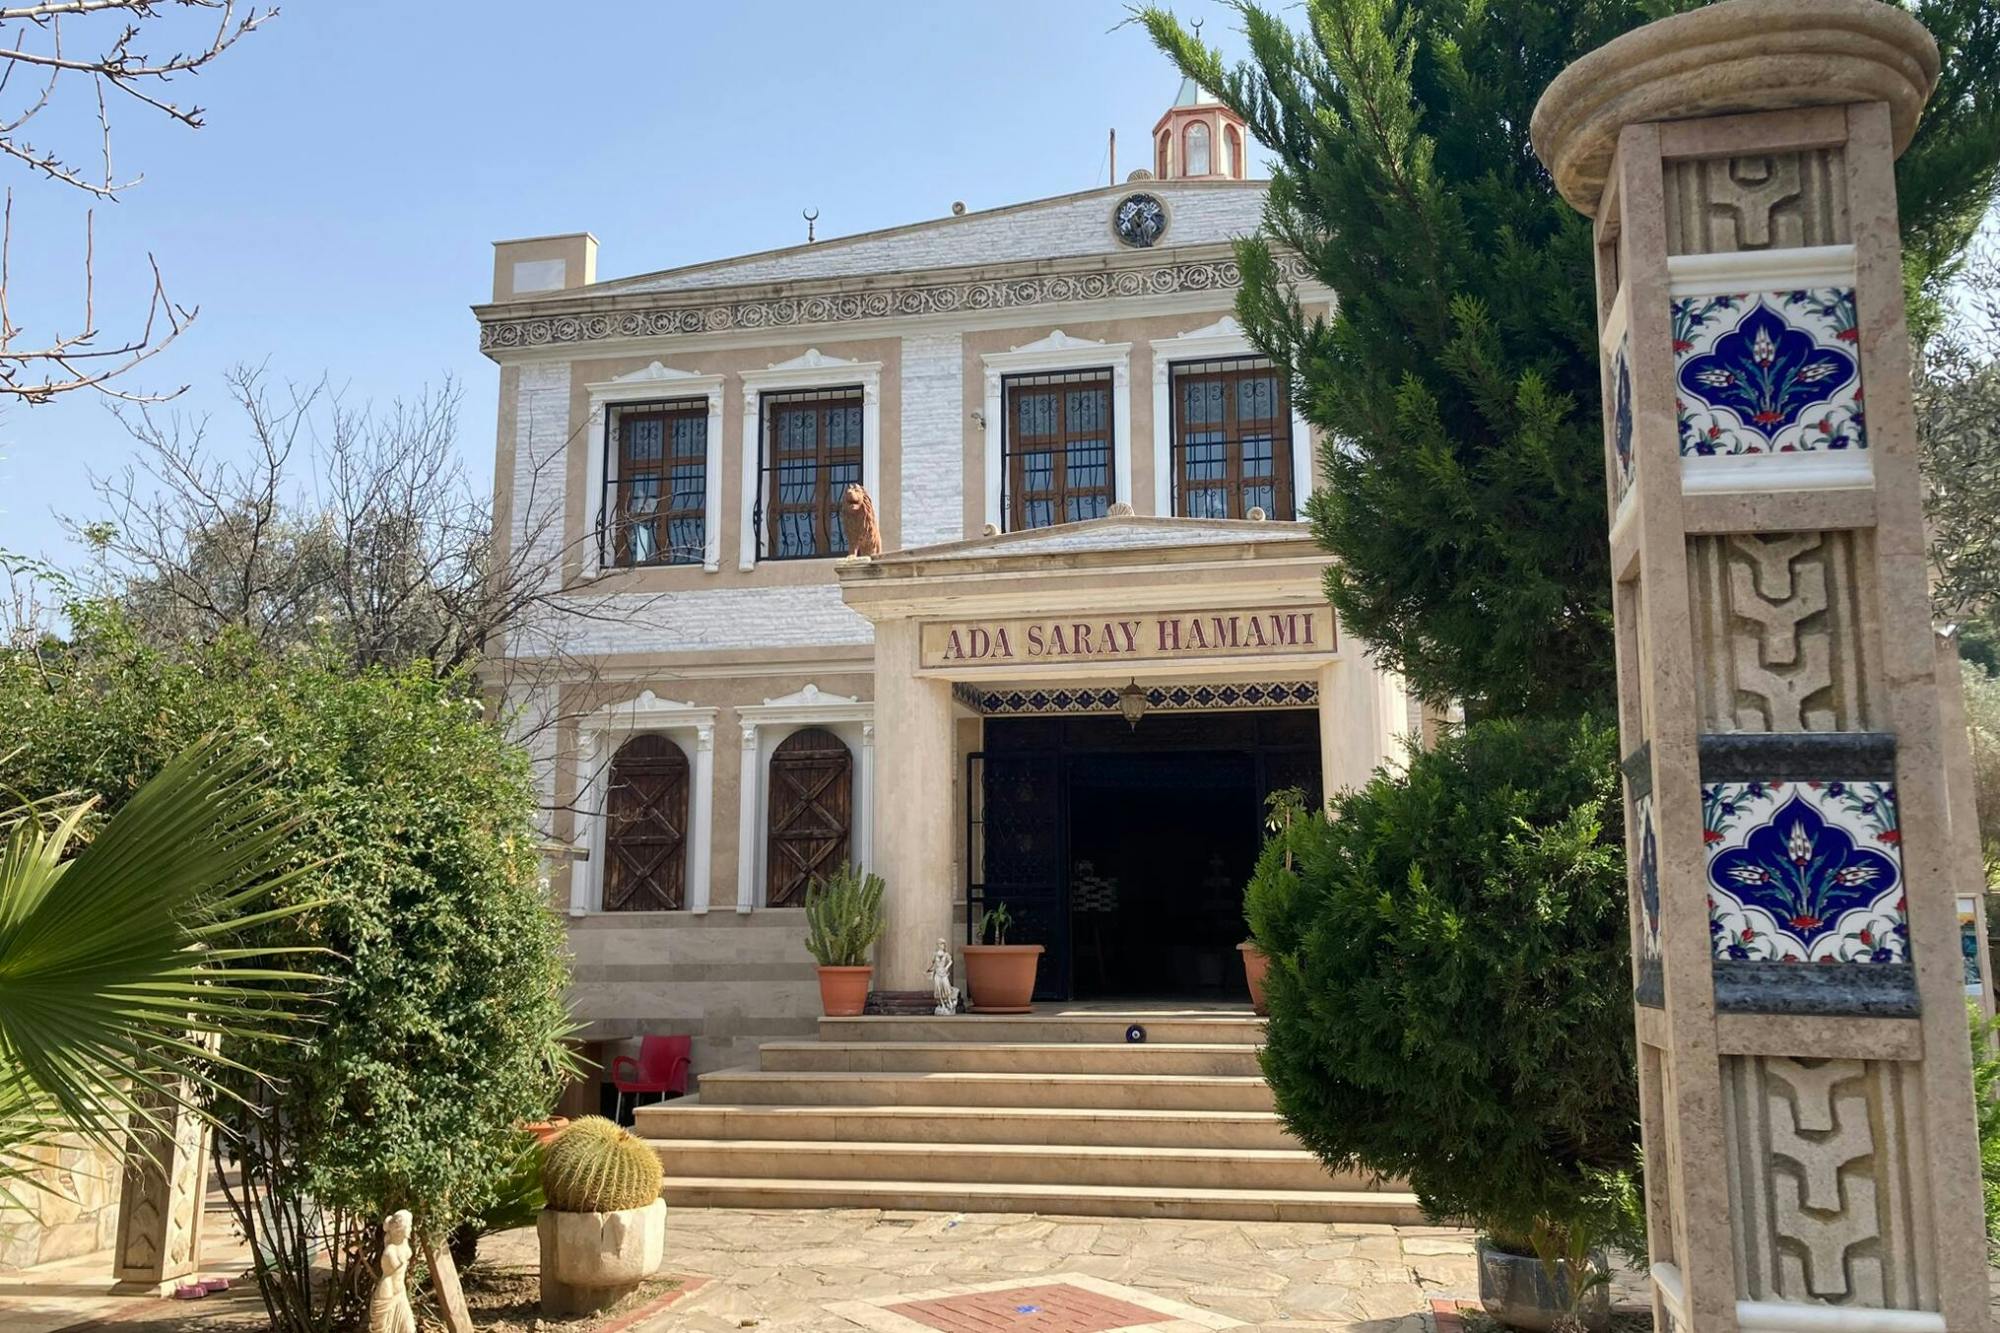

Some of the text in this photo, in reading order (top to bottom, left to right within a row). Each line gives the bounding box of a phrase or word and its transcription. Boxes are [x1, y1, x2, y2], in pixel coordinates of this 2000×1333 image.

[943, 613, 1315, 660] ADA SARAY HAMAMI
